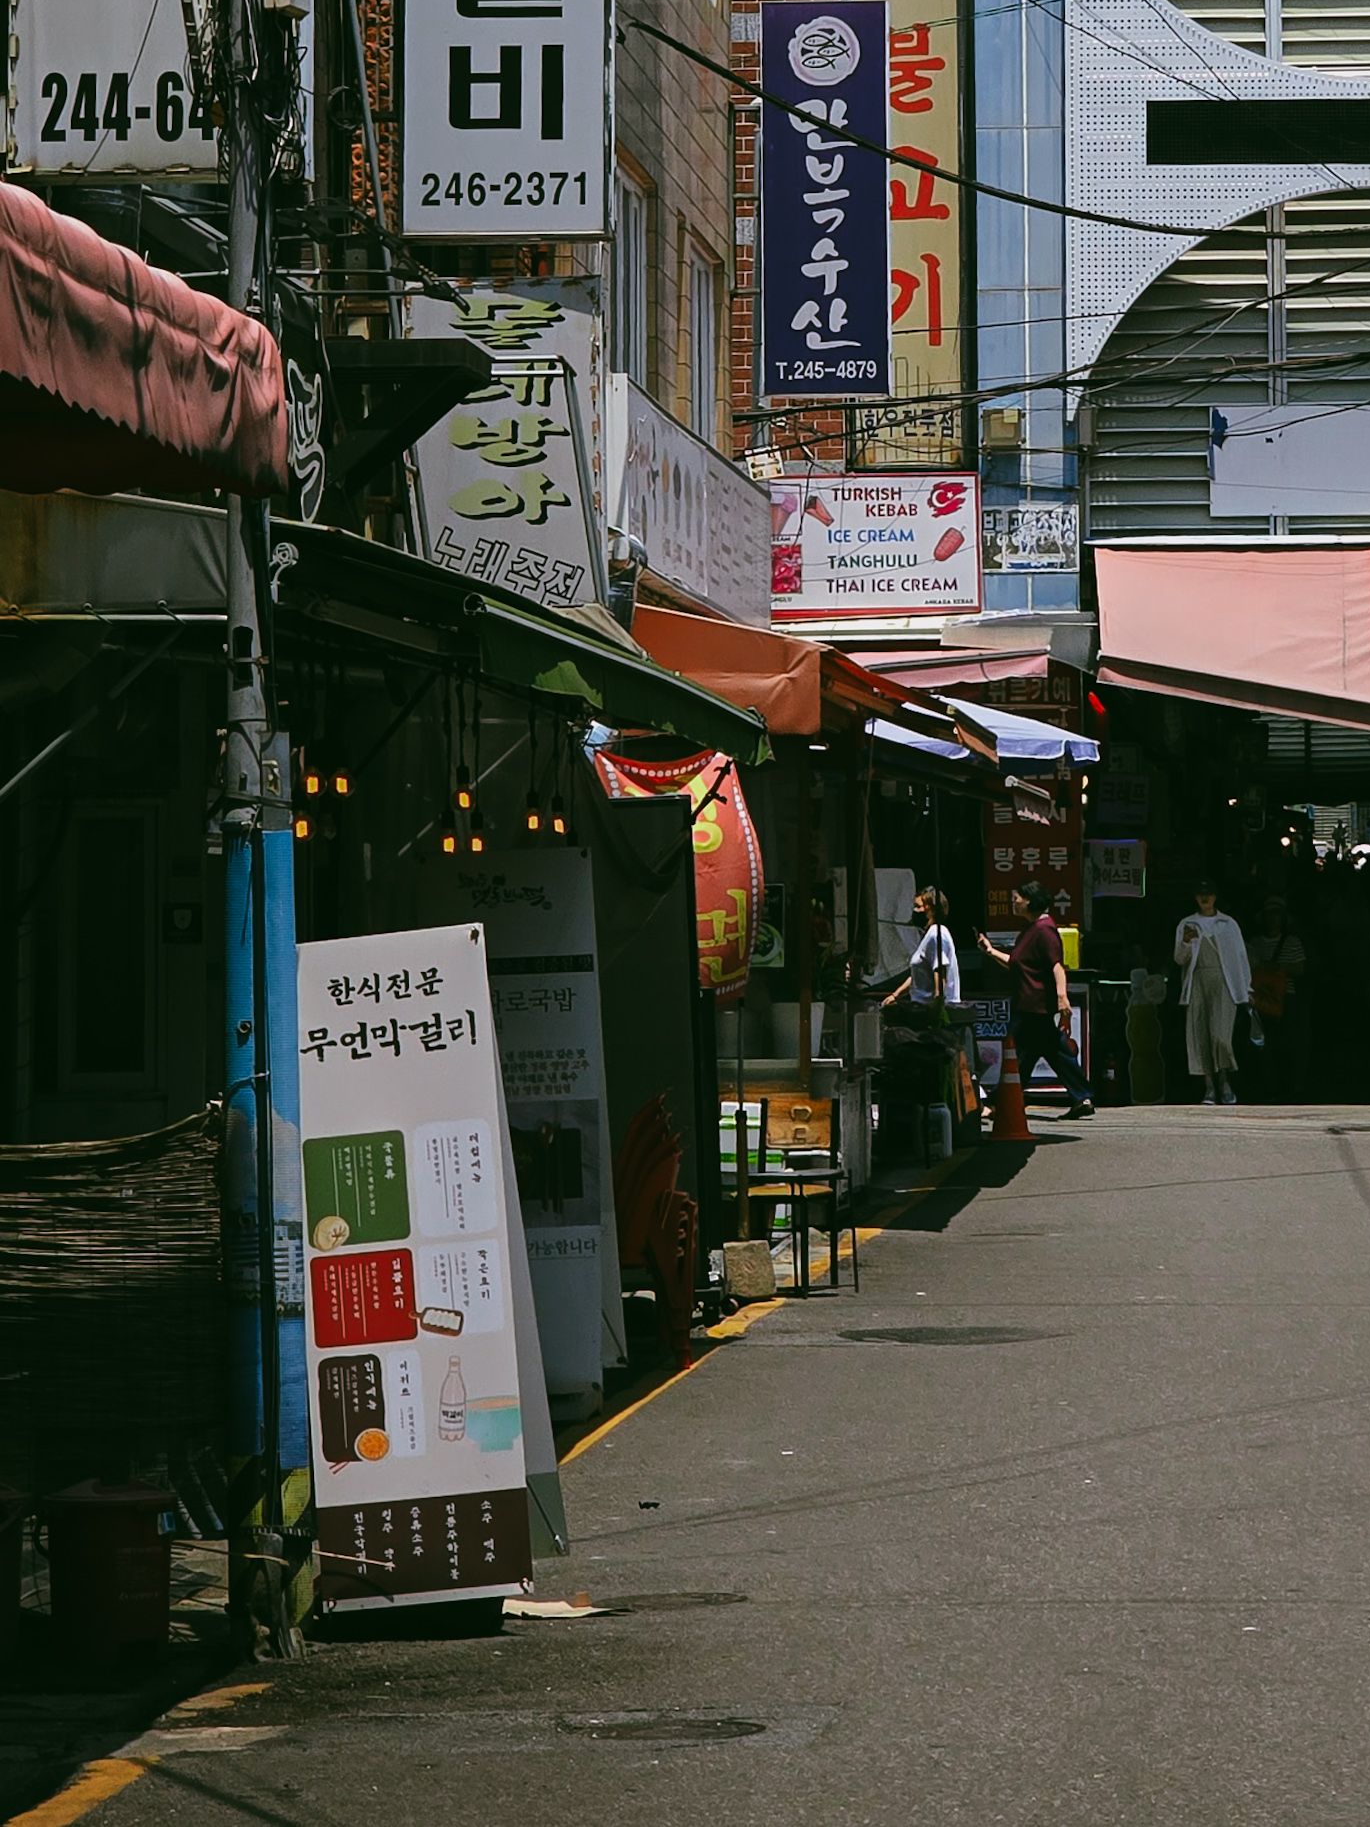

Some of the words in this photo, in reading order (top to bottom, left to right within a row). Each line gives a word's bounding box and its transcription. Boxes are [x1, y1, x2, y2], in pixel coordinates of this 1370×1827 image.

[421, 172, 588, 207] 246-2371
[831, 487, 902, 502] TURKISH
[865, 503, 918, 518] KEBAB
[828, 529, 852, 544] ICE
[857, 529, 915, 543] CREAM
[828, 554, 918, 570] TANGHULU
[826, 579, 864, 593] THAI
[871, 579, 895, 592] ICE
[901, 578, 958, 592] CREAM
[993, 845, 1068, 873] 탕후루
[327, 966, 445, 1007] 한식전문
[300, 1009, 478, 1063] 무언막걸리
